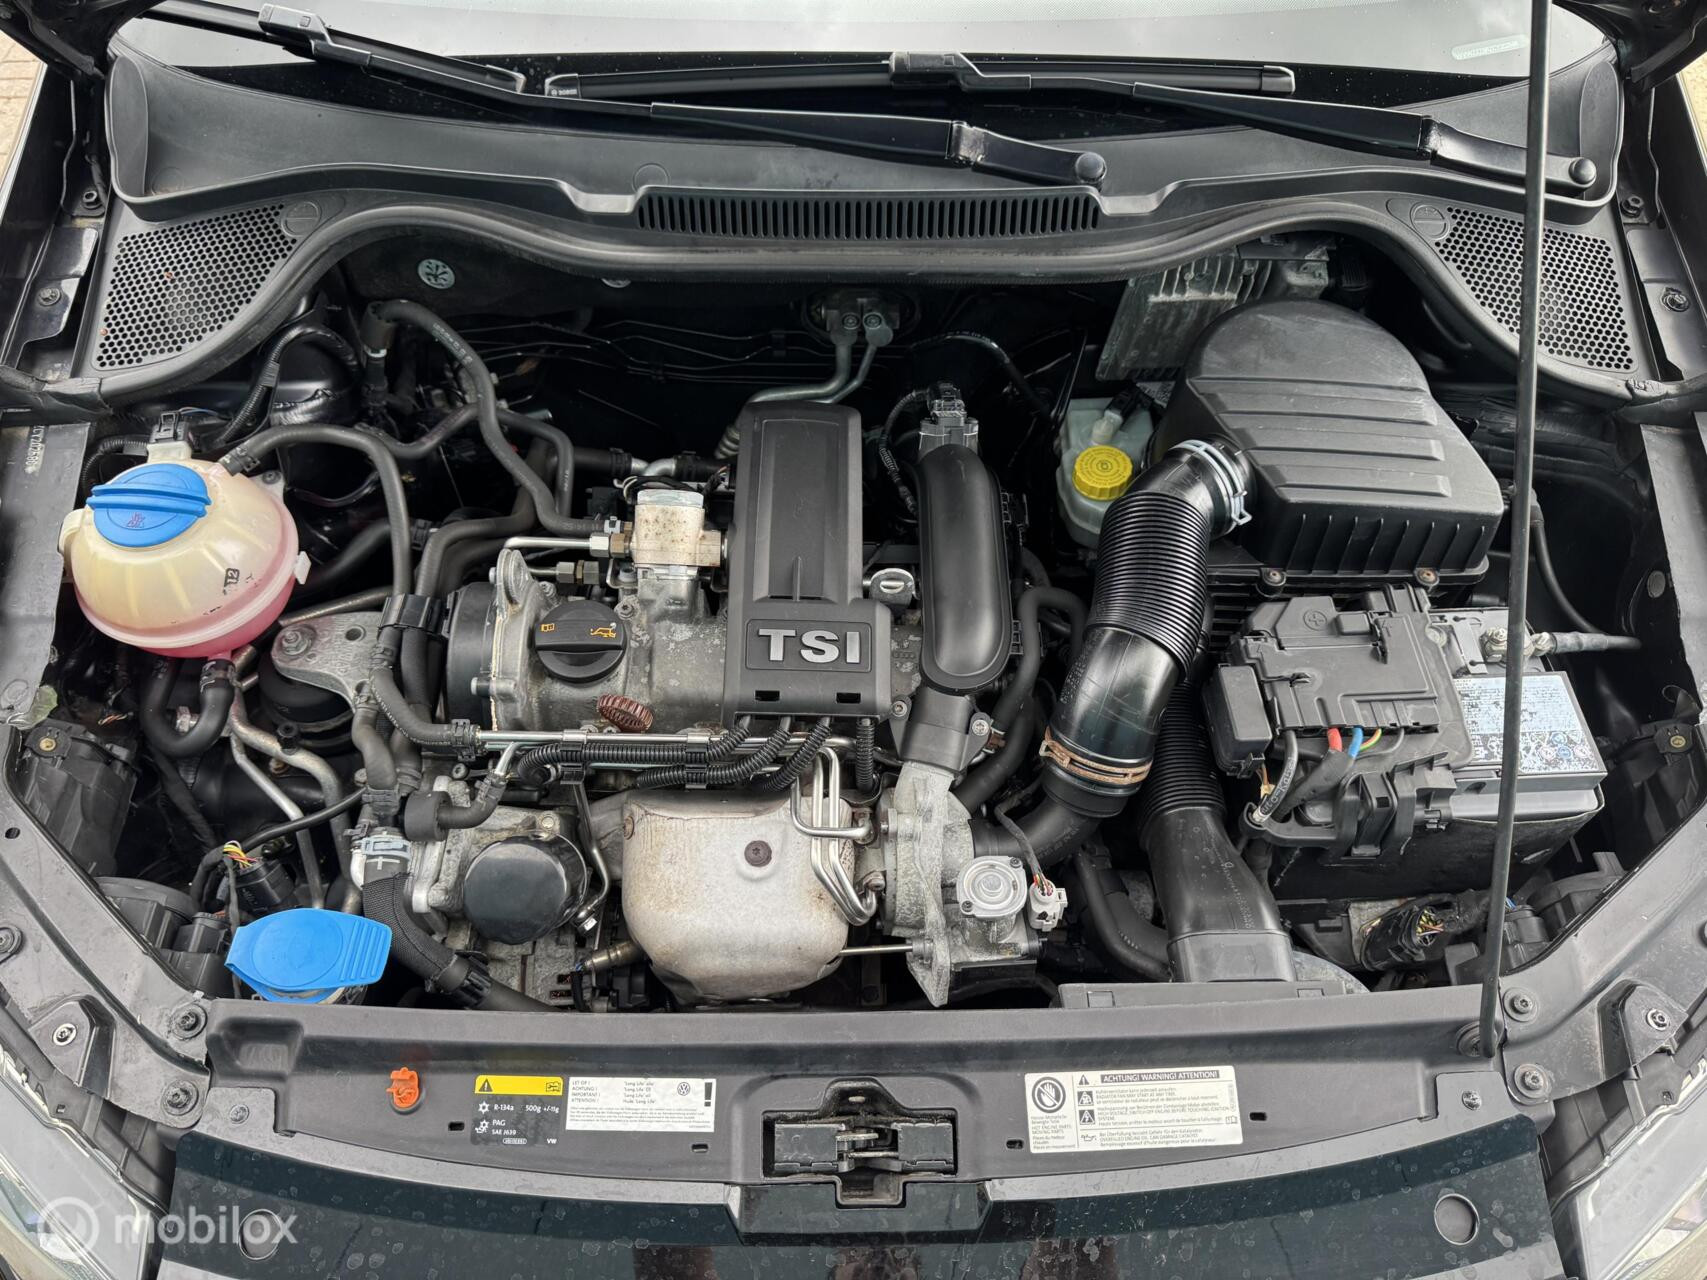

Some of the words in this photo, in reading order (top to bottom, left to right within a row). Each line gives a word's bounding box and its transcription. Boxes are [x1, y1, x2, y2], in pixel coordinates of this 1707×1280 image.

[758, 628, 860, 663] TSI
[1103, 1073, 1140, 1083] ACHTUNG!
[1141, 1072, 1177, 1081] WARNING!
[1178, 1070, 1218, 1080] ATTENTION!
